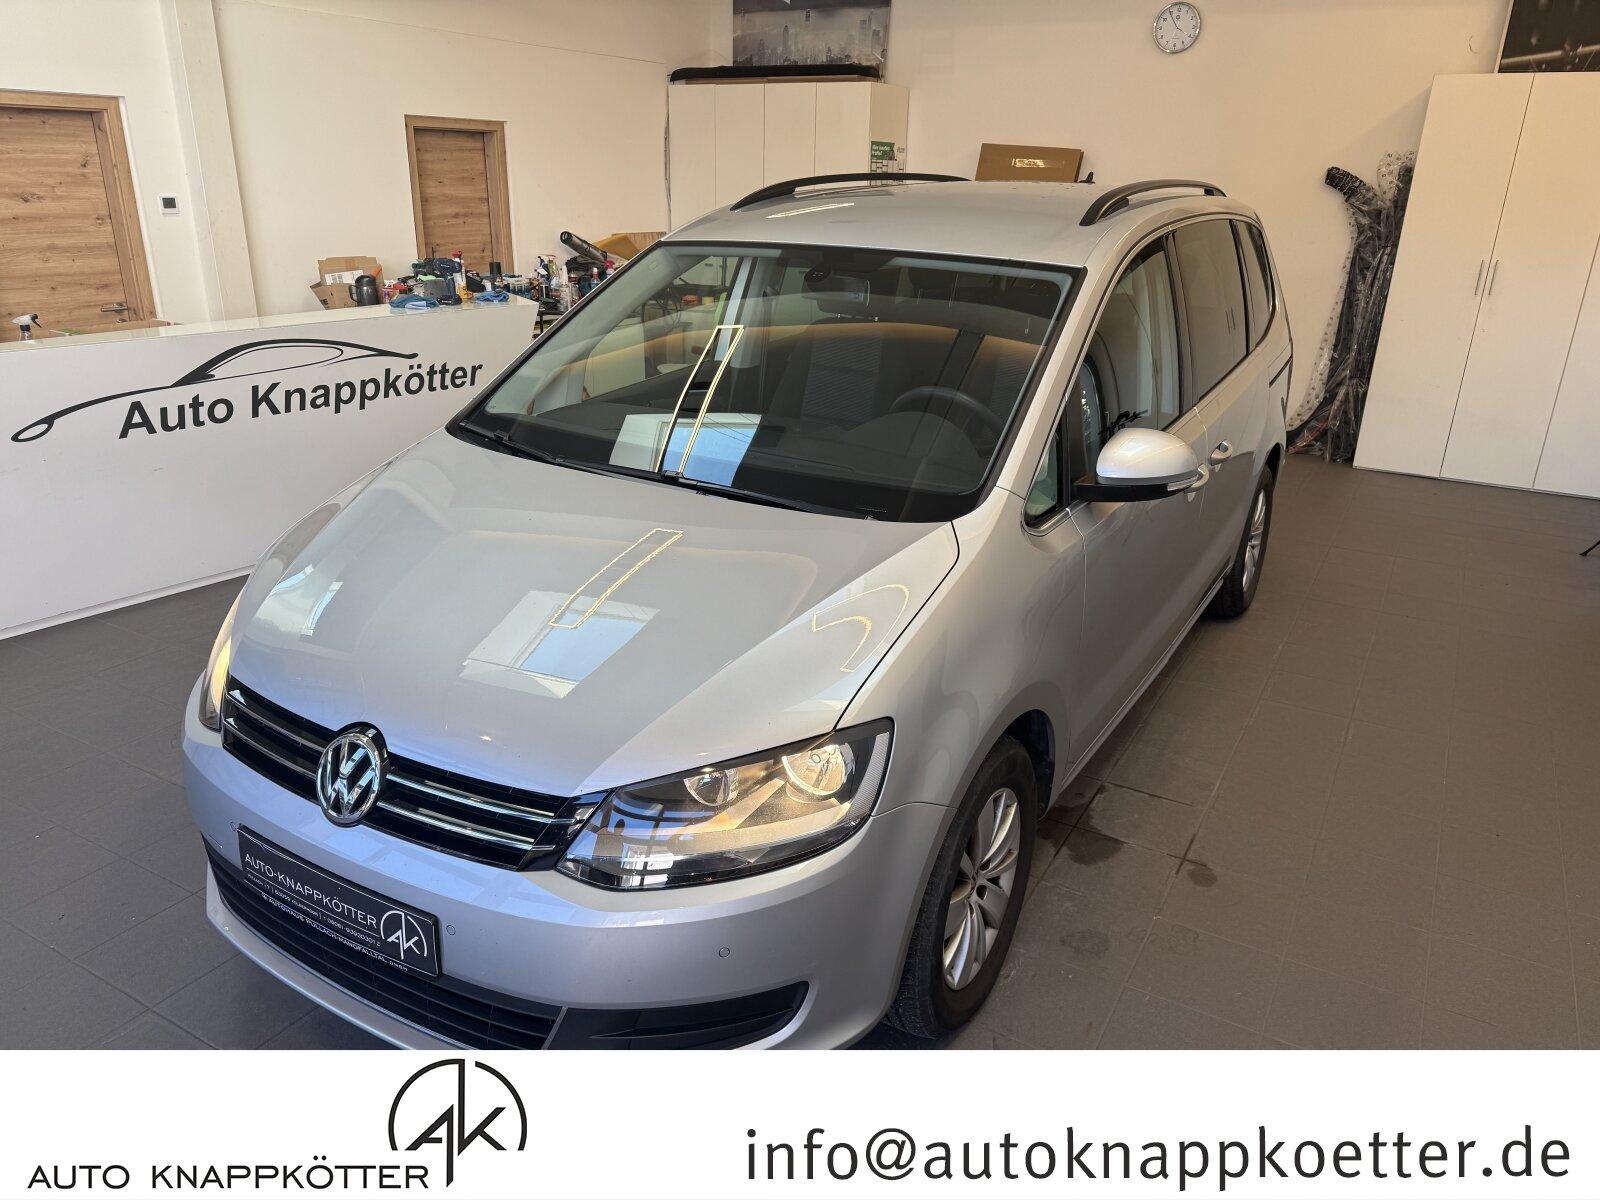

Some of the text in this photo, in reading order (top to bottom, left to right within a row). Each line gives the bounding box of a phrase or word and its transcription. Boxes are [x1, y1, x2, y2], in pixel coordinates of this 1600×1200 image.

[118, 361, 483, 440] Auto Knappkötter
[245, 853, 377, 929] AUTO-KNAPPKÖTTER
